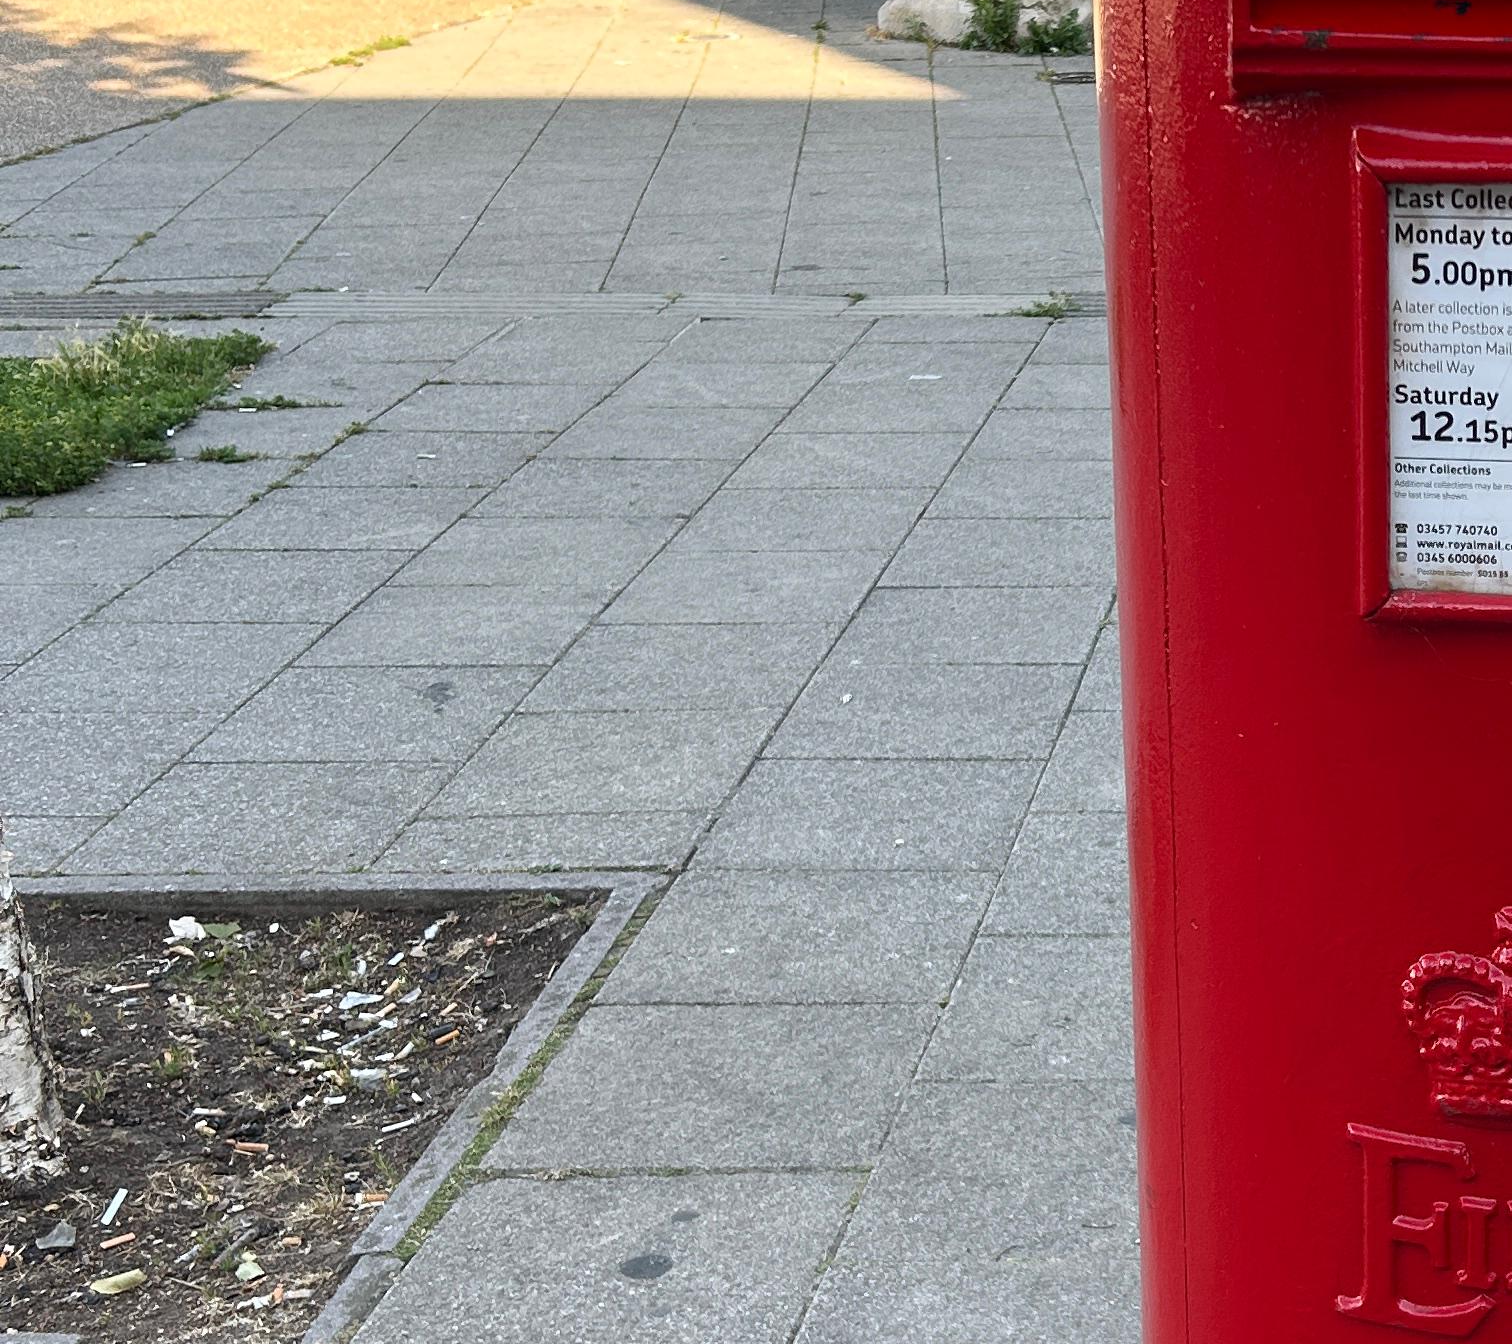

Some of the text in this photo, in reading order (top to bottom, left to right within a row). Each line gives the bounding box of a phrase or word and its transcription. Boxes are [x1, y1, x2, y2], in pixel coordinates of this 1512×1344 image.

[1394, 188, 1444, 209] Last
[1395, 223, 1485, 249] Monday
[1393, 300, 1402, 313] A
[1405, 301, 1433, 314] later
[1438, 302, 1499, 316] collection
[1502, 304, 1512, 316] is
[1392, 320, 1424, 334] from
[1428, 321, 1449, 334] the
[1452, 322, 1504, 336] Postbox
[1393, 340, 1482, 356] Southampton
[1486, 342, 1512, 356] Mail
[1393, 360, 1475, 376] Mitchell Way
[1394, 385, 1499, 410] Saturday
[1394, 462, 1491, 476] Other Collections
[1394, 480, 1433, 489] Additional
[1433, 481, 1473, 490] collections
[1475, 483, 1492, 491] may
[1492, 482, 1503, 491] be
[1417, 524, 1498, 536] 03457 740740
[1417, 553, 1497, 565] 0345 6000606
